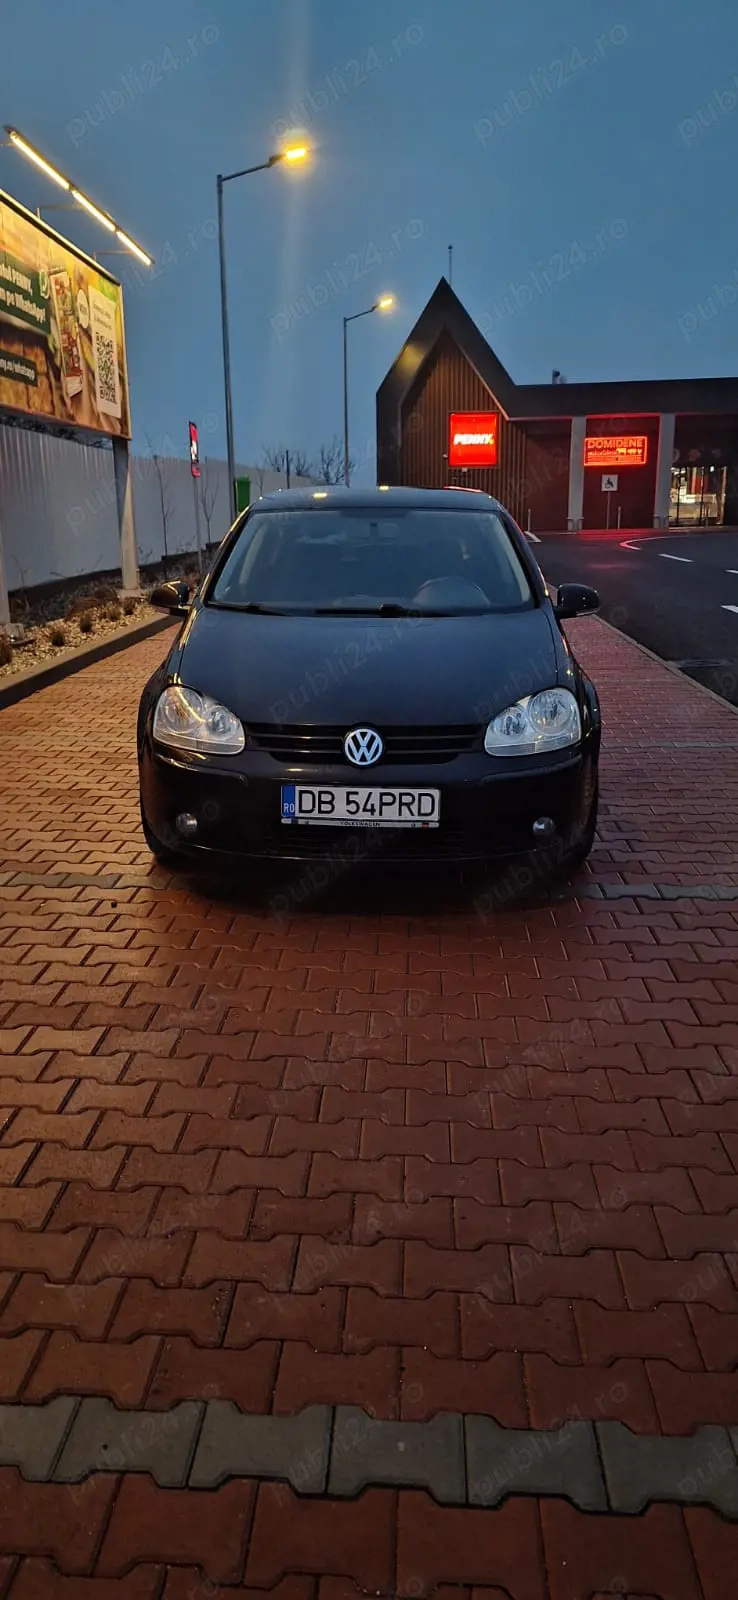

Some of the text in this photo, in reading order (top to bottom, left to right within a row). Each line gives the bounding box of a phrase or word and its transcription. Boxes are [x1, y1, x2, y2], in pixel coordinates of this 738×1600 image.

[345, 729, 382, 765] VW
[283, 789, 435, 817] RO DB 54PRD
